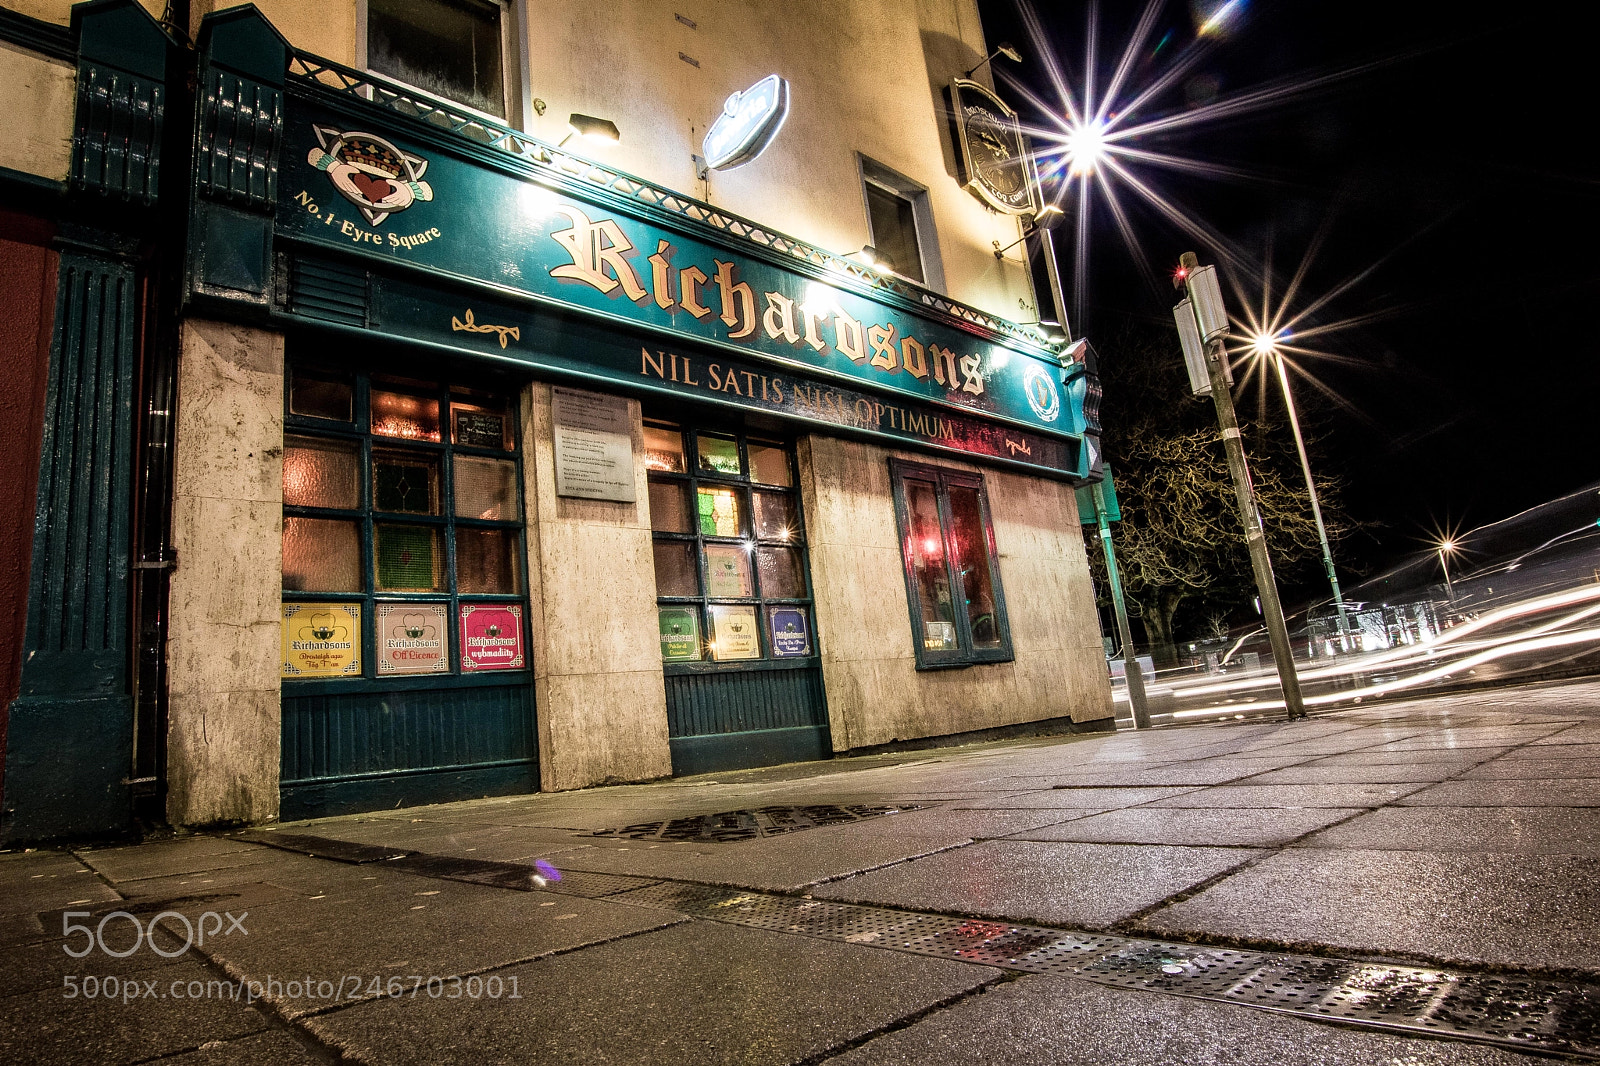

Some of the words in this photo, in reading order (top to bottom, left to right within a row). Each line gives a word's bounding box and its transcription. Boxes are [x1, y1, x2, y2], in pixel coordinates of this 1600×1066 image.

[340, 219, 383, 244] Eyre
[387, 226, 442, 250] Square
[549, 203, 985, 396] Richardsons
[639, 347, 699, 387] NIL
[708, 363, 784, 404] SATIS
[793, 383, 844, 417] NISI
[855, 398, 955, 441] OPTIMUM
[291, 640, 351, 651] Richardsons
[386, 639, 440, 650] Richardsons
[468, 636, 517, 648] Richardsons
[392, 650, 408, 660] Off
[409, 649, 440, 660] Licence
